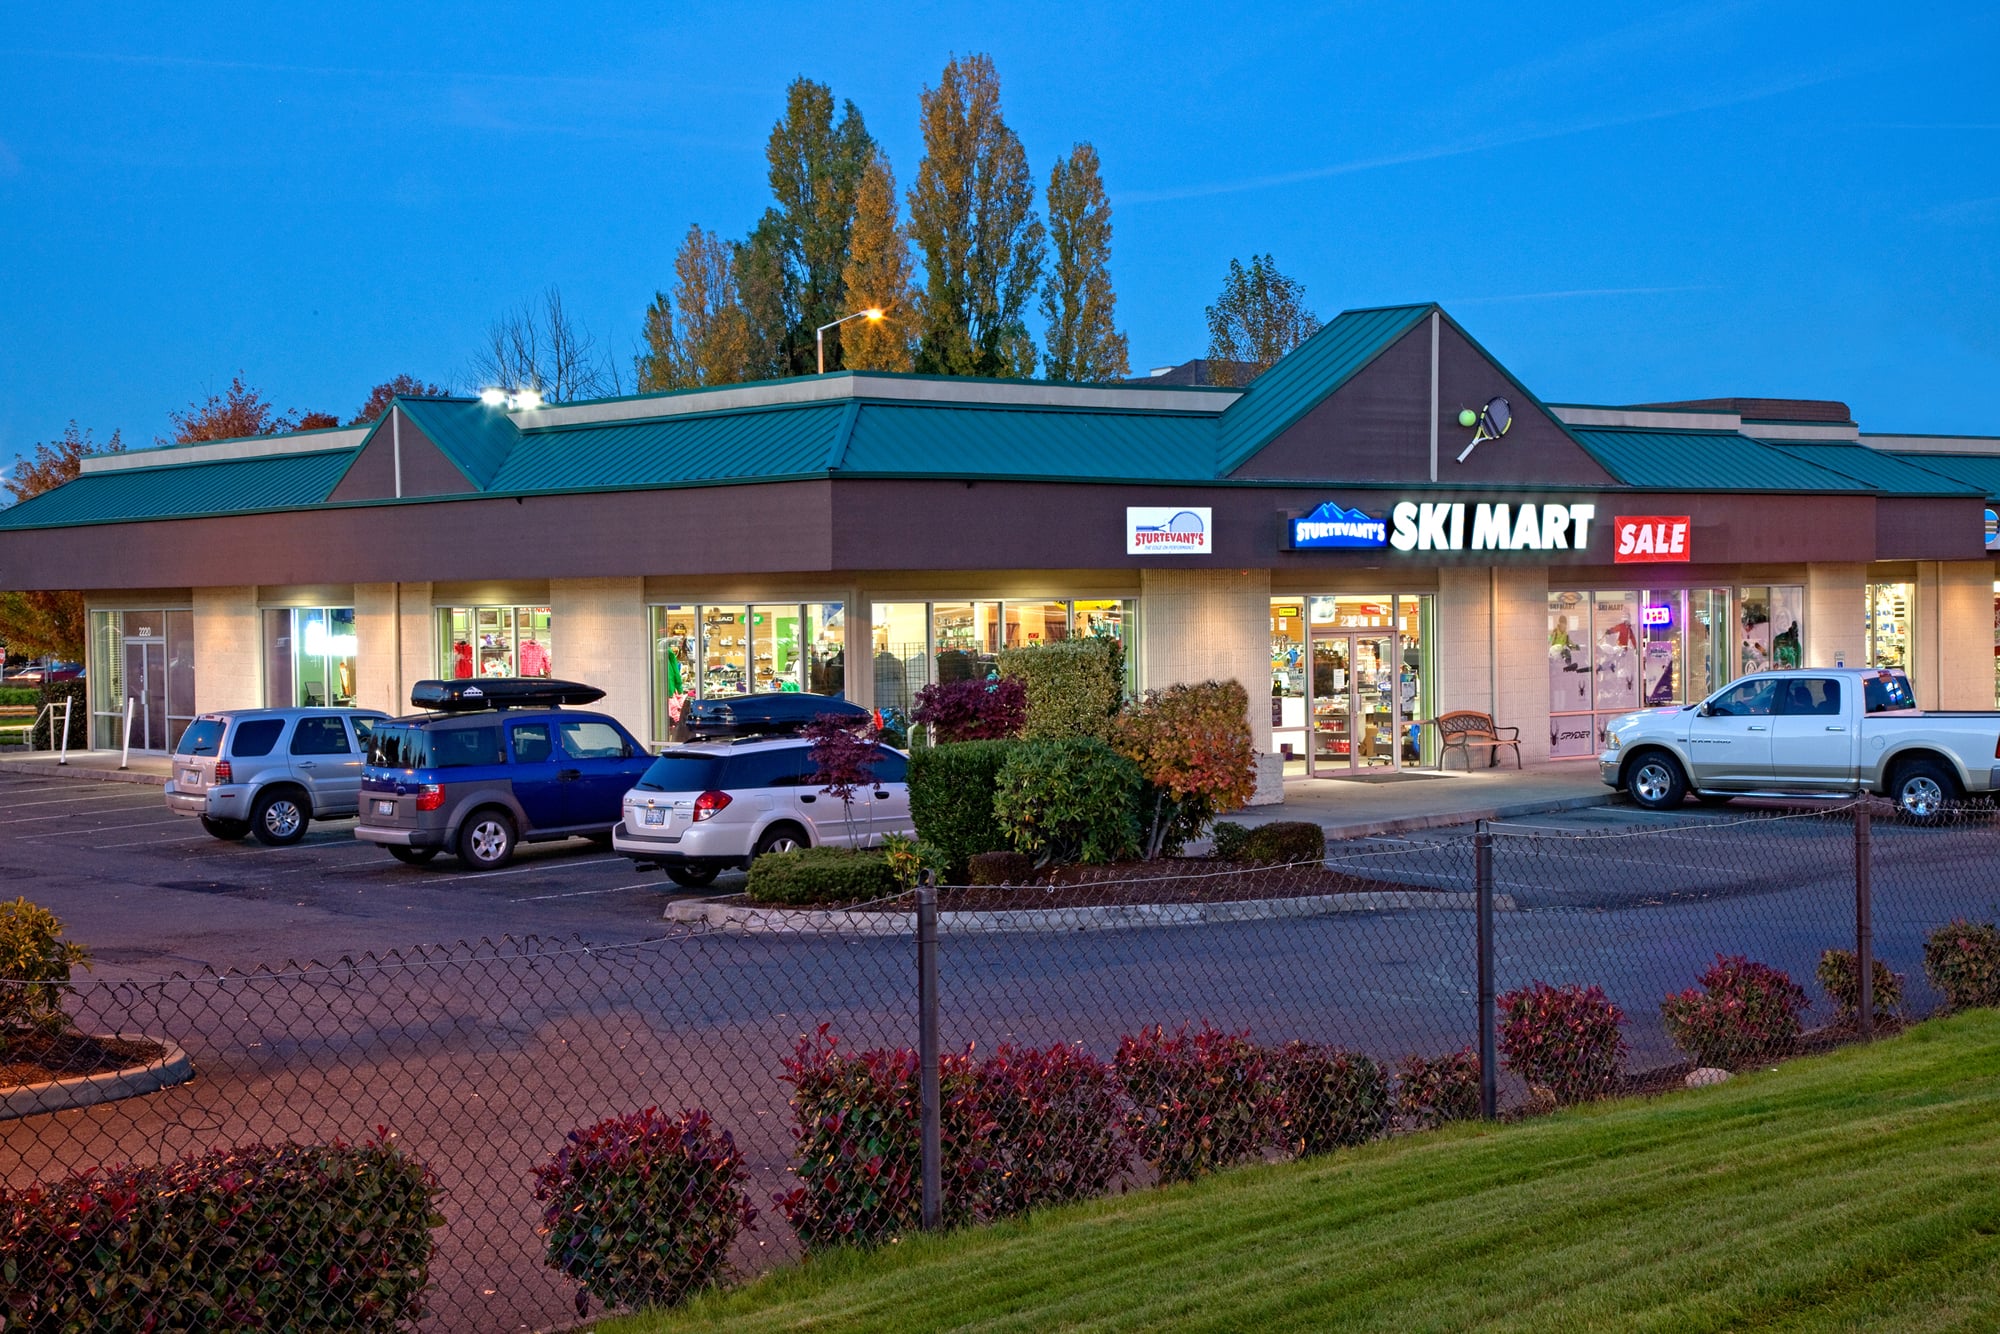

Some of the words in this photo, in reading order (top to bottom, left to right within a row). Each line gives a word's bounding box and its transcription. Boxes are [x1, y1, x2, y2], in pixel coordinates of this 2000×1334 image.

[1297, 522, 1385, 542] STURTEVANT'S
[1390, 501, 1466, 551] SKI
[1471, 503, 1595, 550] MART
[1135, 533, 1204, 546] STURTEVANT'S
[1618, 523, 1688, 555] SALE
[1560, 731, 1591, 740] SPYDER
